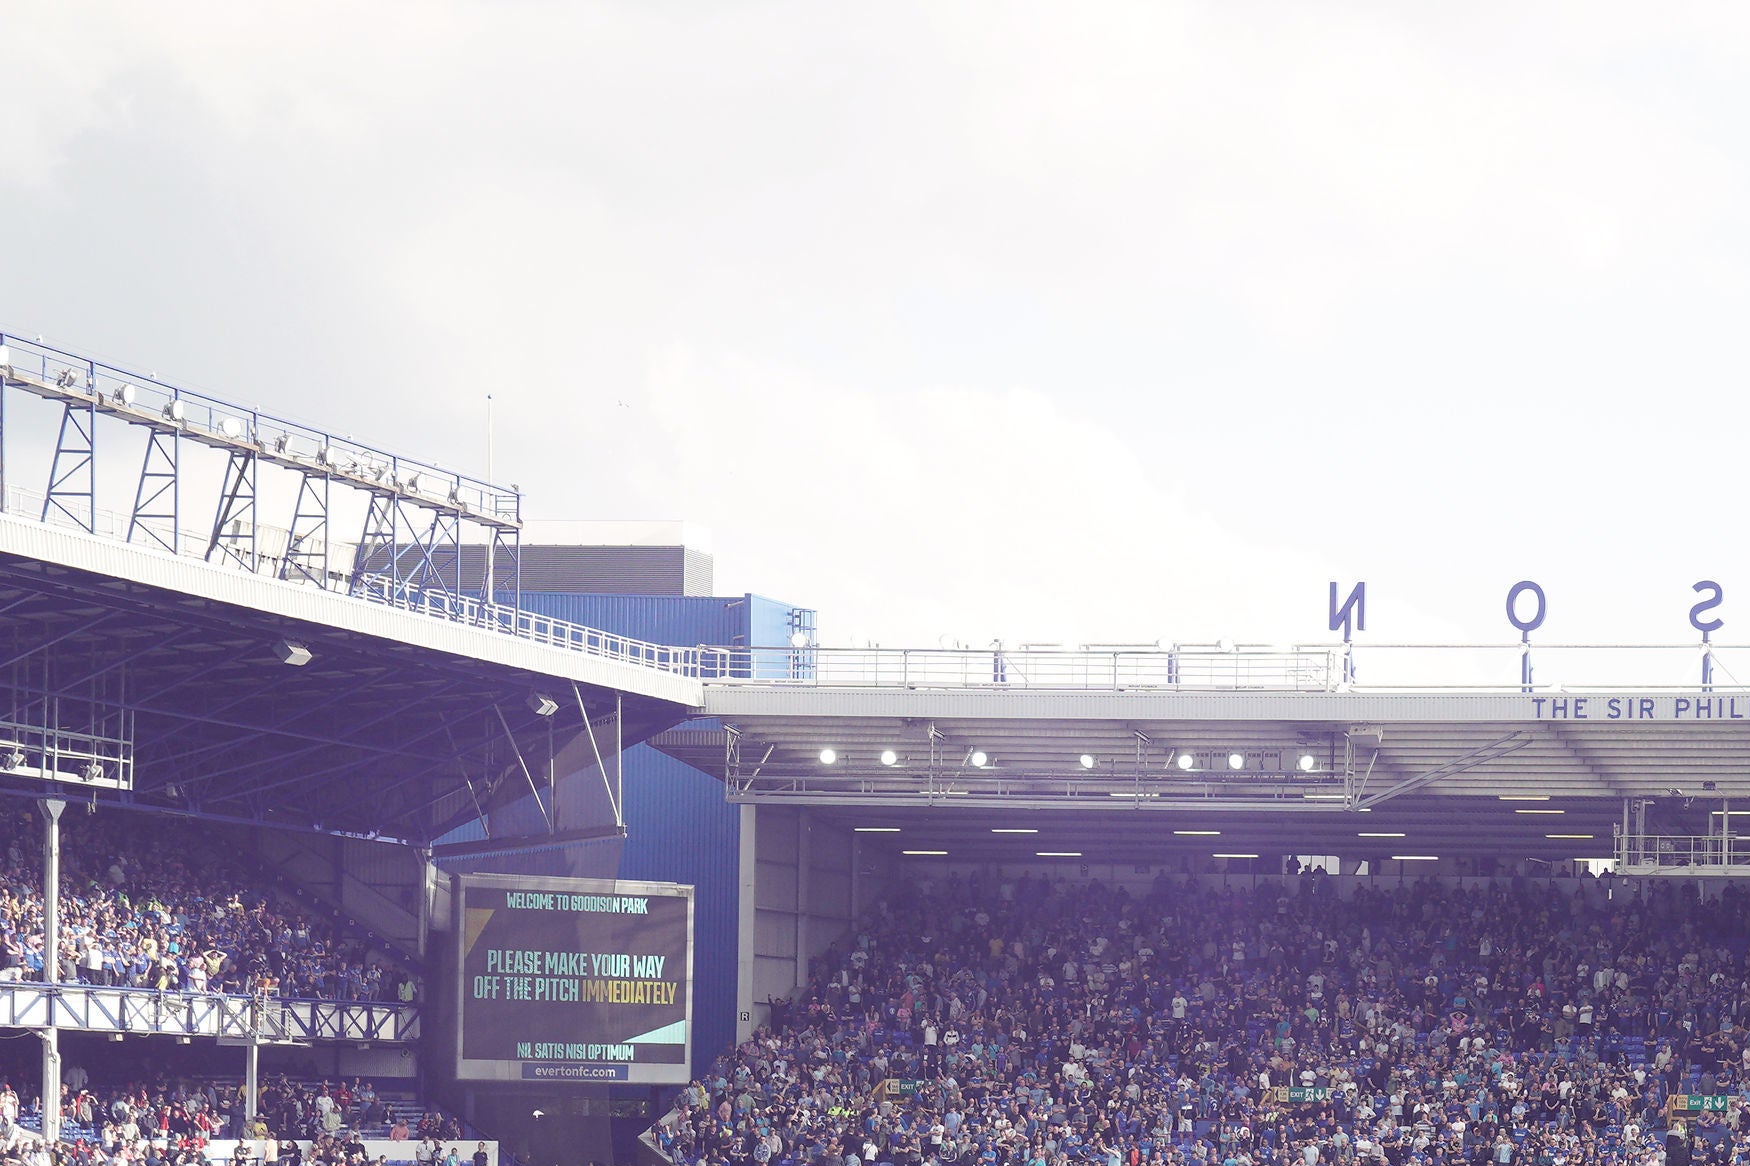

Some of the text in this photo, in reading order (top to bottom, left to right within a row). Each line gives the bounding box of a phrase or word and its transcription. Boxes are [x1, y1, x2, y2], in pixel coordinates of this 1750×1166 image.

[1532, 698, 1588, 718] THE
[1607, 698, 1655, 718] SIR
[506, 892, 648, 915] WELCOME TO GOODISON PARK
[487, 949, 666, 979] PLEASE MAKE YOUR WAY
[473, 975, 678, 1006] OFF THE PITCH IMMEDIATELY
[517, 1041, 635, 1062] NIL SATIS NISI OPTIMUM
[535, 1065, 616, 1079] evertonfc.com
